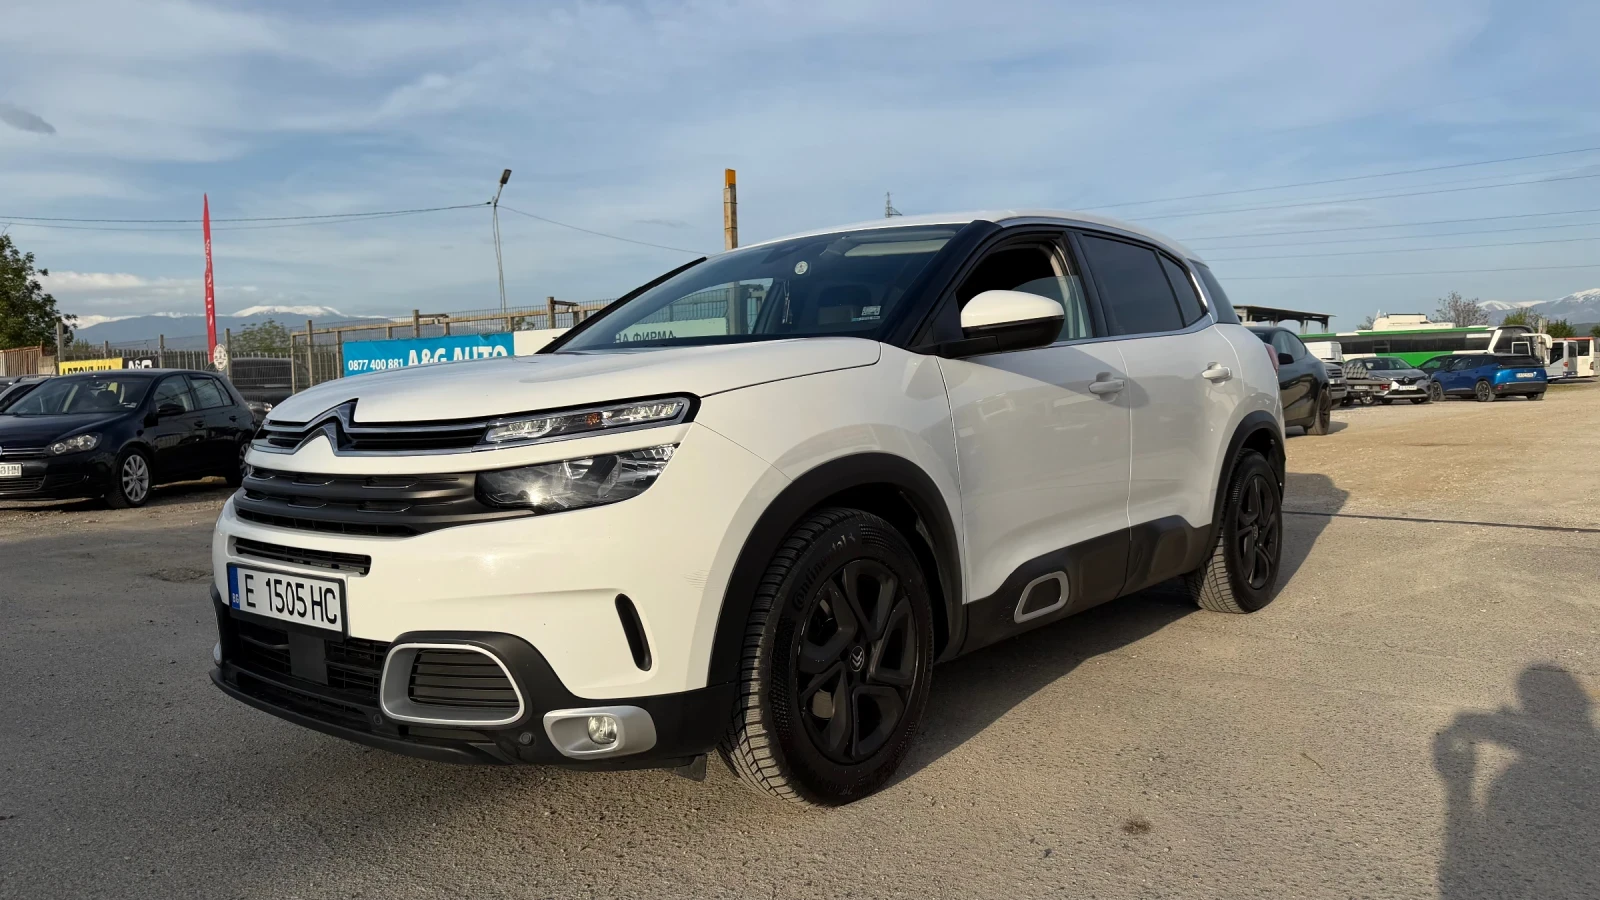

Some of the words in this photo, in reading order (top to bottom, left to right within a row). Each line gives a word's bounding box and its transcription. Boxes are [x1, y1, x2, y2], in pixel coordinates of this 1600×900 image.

[633, 330, 675, 342] ФИРМА
[408, 348, 447, 366] A&G
[453, 344, 509, 361] AUTO
[348, 359, 368, 371] 0877
[370, 358, 387, 370] 400
[388, 358, 404, 369] 881
[244, 573, 257, 608] E
[265, 577, 308, 618] 1505
[309, 584, 338, 625] HC
